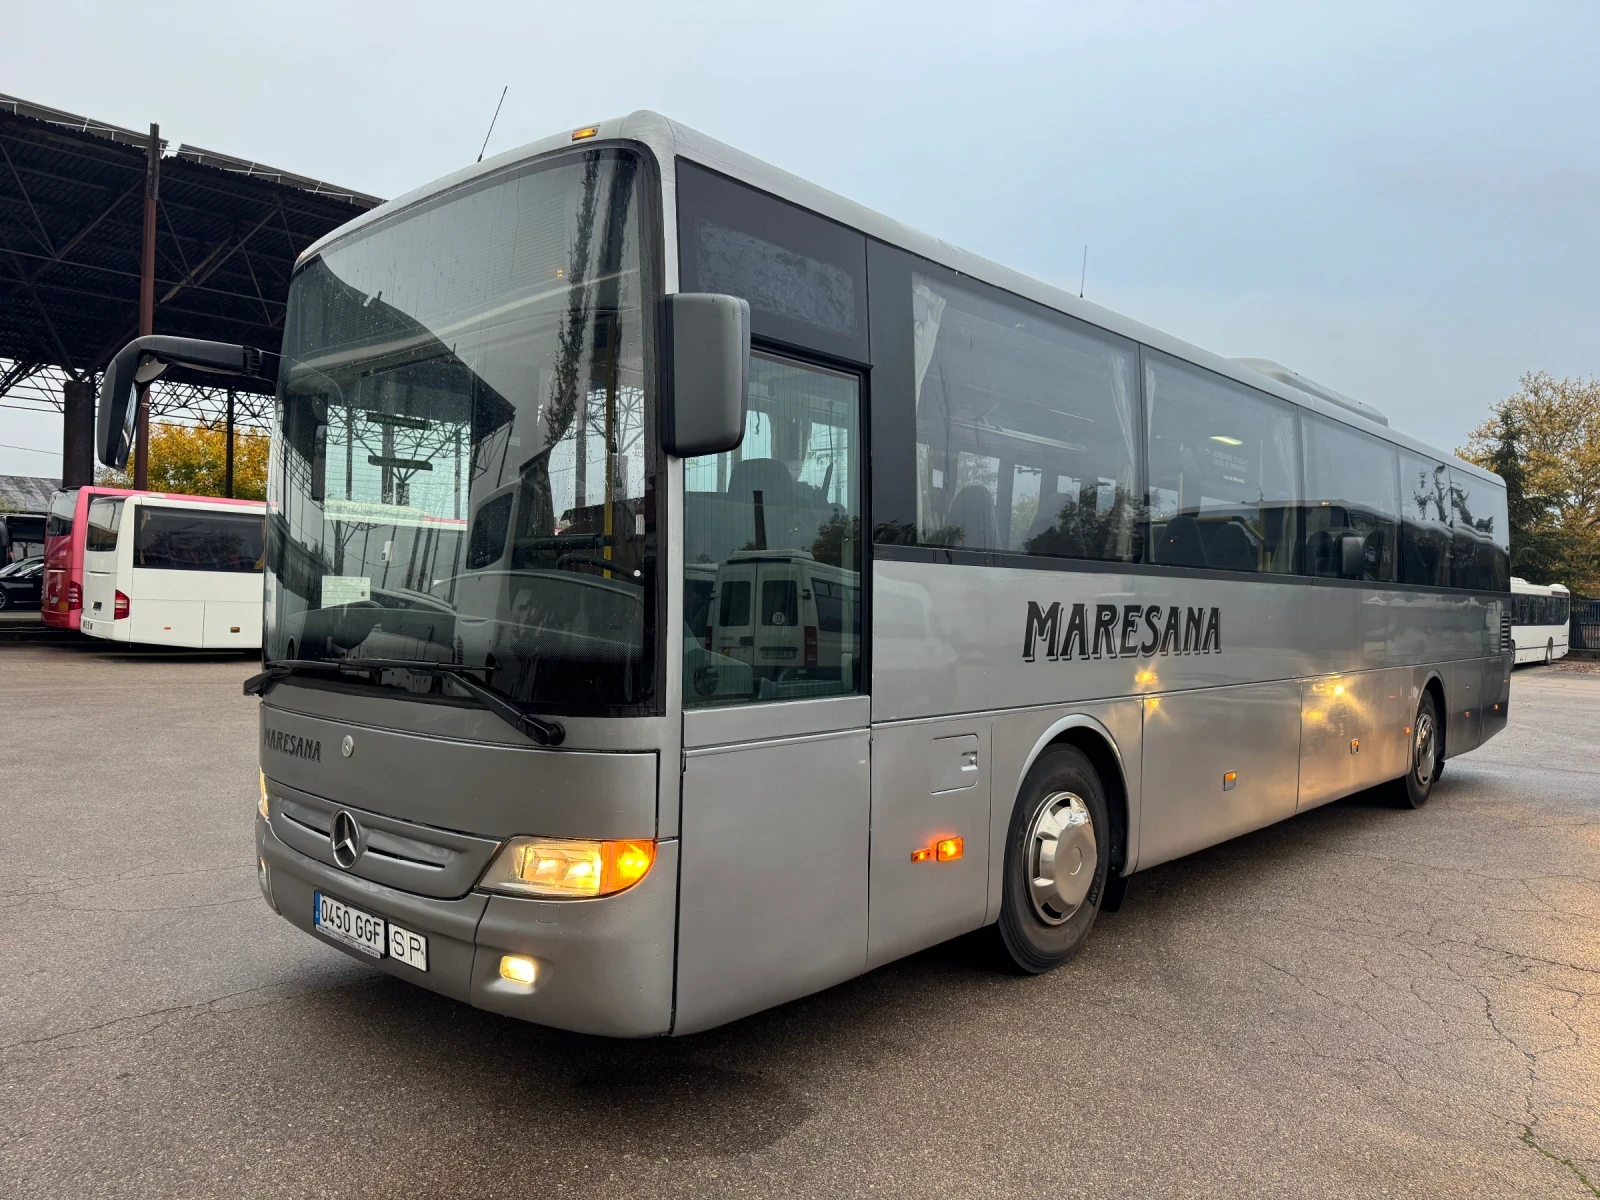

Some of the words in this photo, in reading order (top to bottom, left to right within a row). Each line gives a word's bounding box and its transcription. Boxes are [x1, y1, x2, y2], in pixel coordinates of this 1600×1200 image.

[1022, 600, 1222, 663] MARESANA
[264, 726, 321, 764] MARESANA
[321, 900, 351, 933] 0450
[355, 915, 381, 944] GGF
[393, 930, 421, 961] SP
